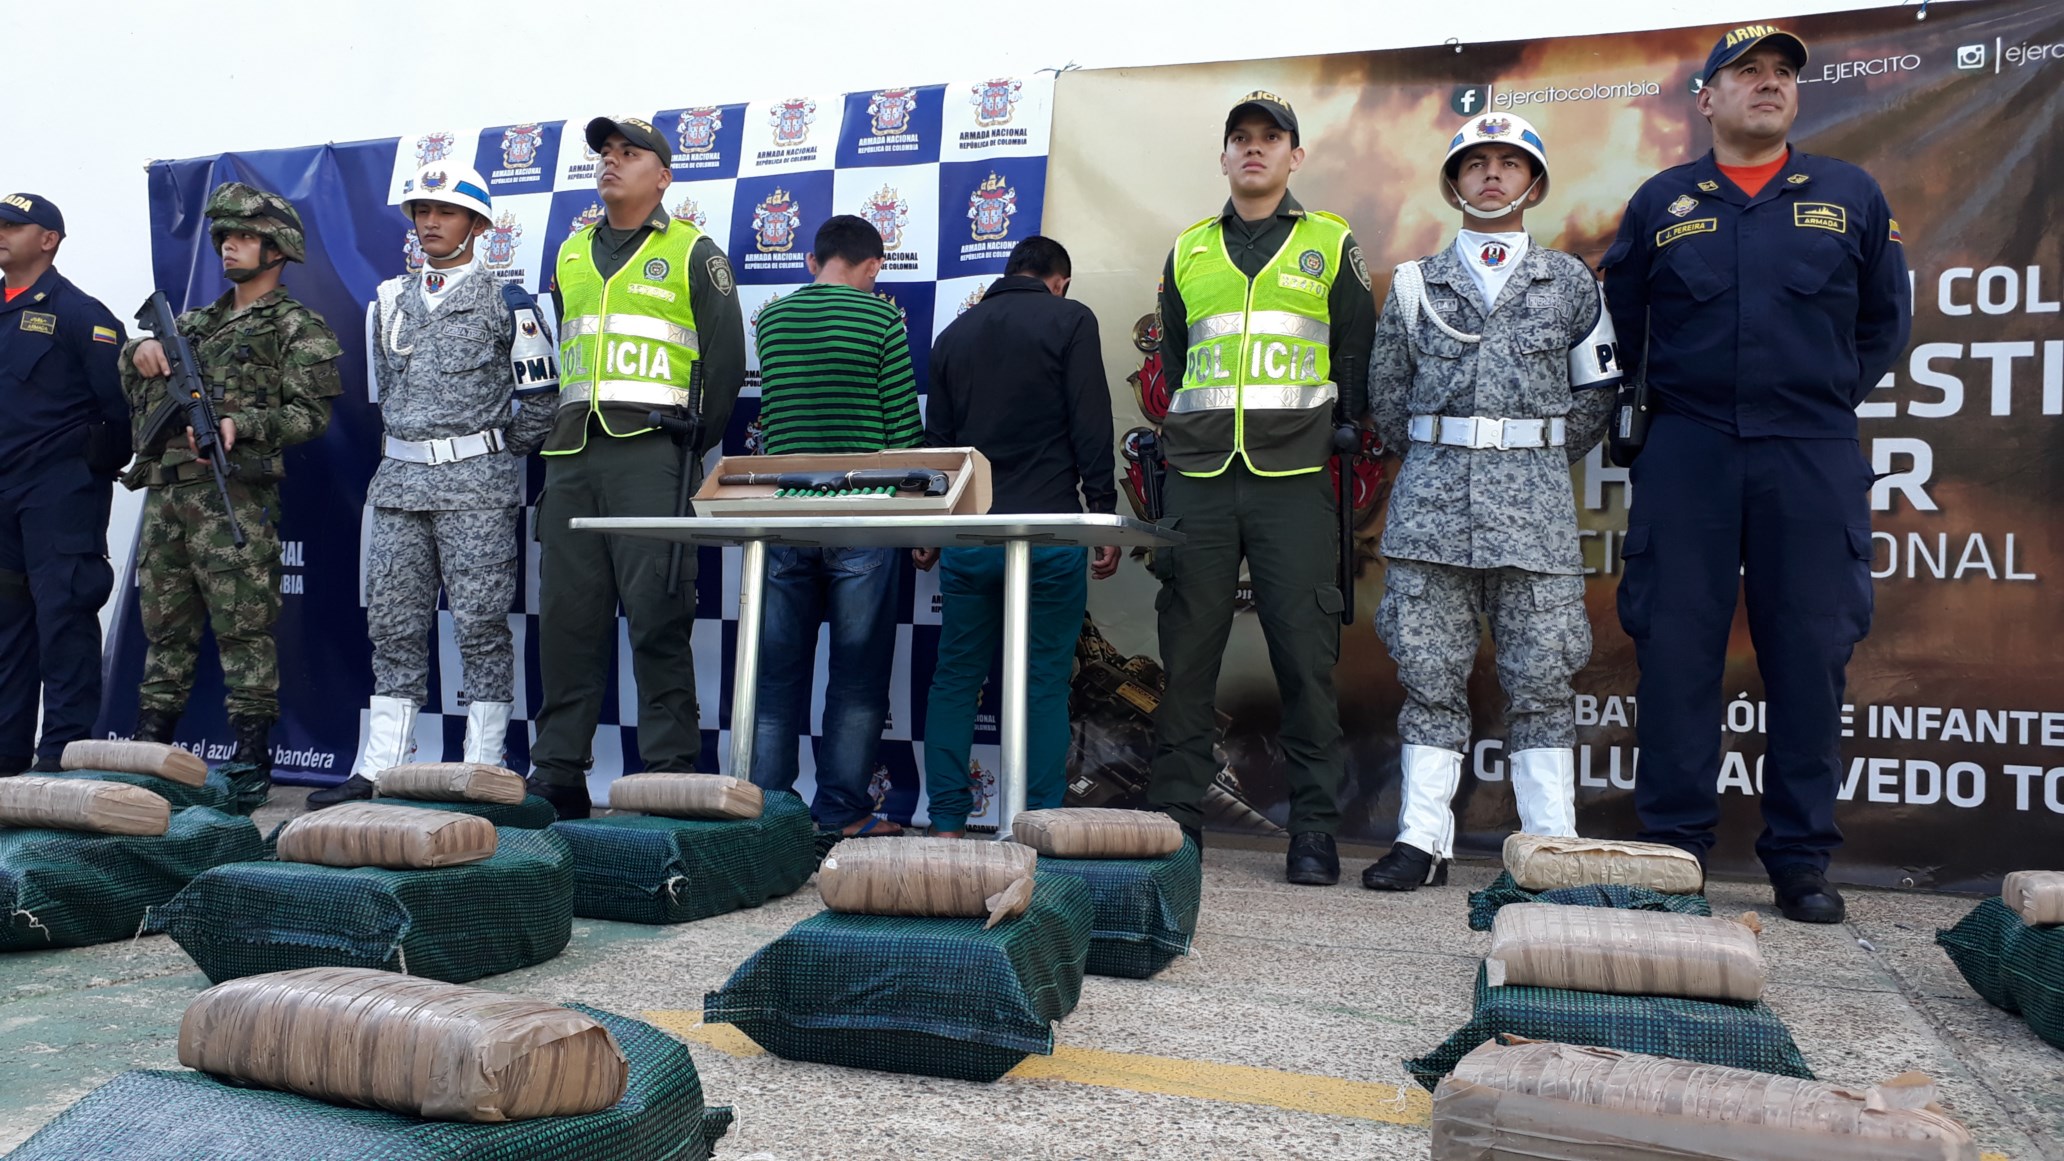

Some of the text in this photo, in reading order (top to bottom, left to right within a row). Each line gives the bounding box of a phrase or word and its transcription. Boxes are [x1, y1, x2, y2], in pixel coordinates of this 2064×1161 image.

[1494, 80, 1660, 109] ejercitocolombia
[858, 134, 919, 146] ARMADA NACIONAL
[960, 128, 1027, 141] ARMADA NACIONAL
[892, 143, 919, 152] COLOMBIA
[959, 139, 989, 149] REPÚBLICA
[996, 137, 1027, 146] COLOMBIA
[691, 152, 720, 161] NACIONAL
[757, 146, 818, 159] ARMADA NACIONAL
[790, 155, 817, 163] COLOMBIA
[492, 167, 542, 178] ARMADA NACIONAL
[569, 164, 594, 173] ARMADA
[1804, 217, 1838, 228] ARMADA
[1673, 223, 1705, 235] PEREIRA
[961, 242, 986, 253] ARMADA
[745, 252, 804, 262] ARMADA NACIONAL
[778, 261, 804, 269] COLOMBIA
[274, 744, 335, 769] bandera
